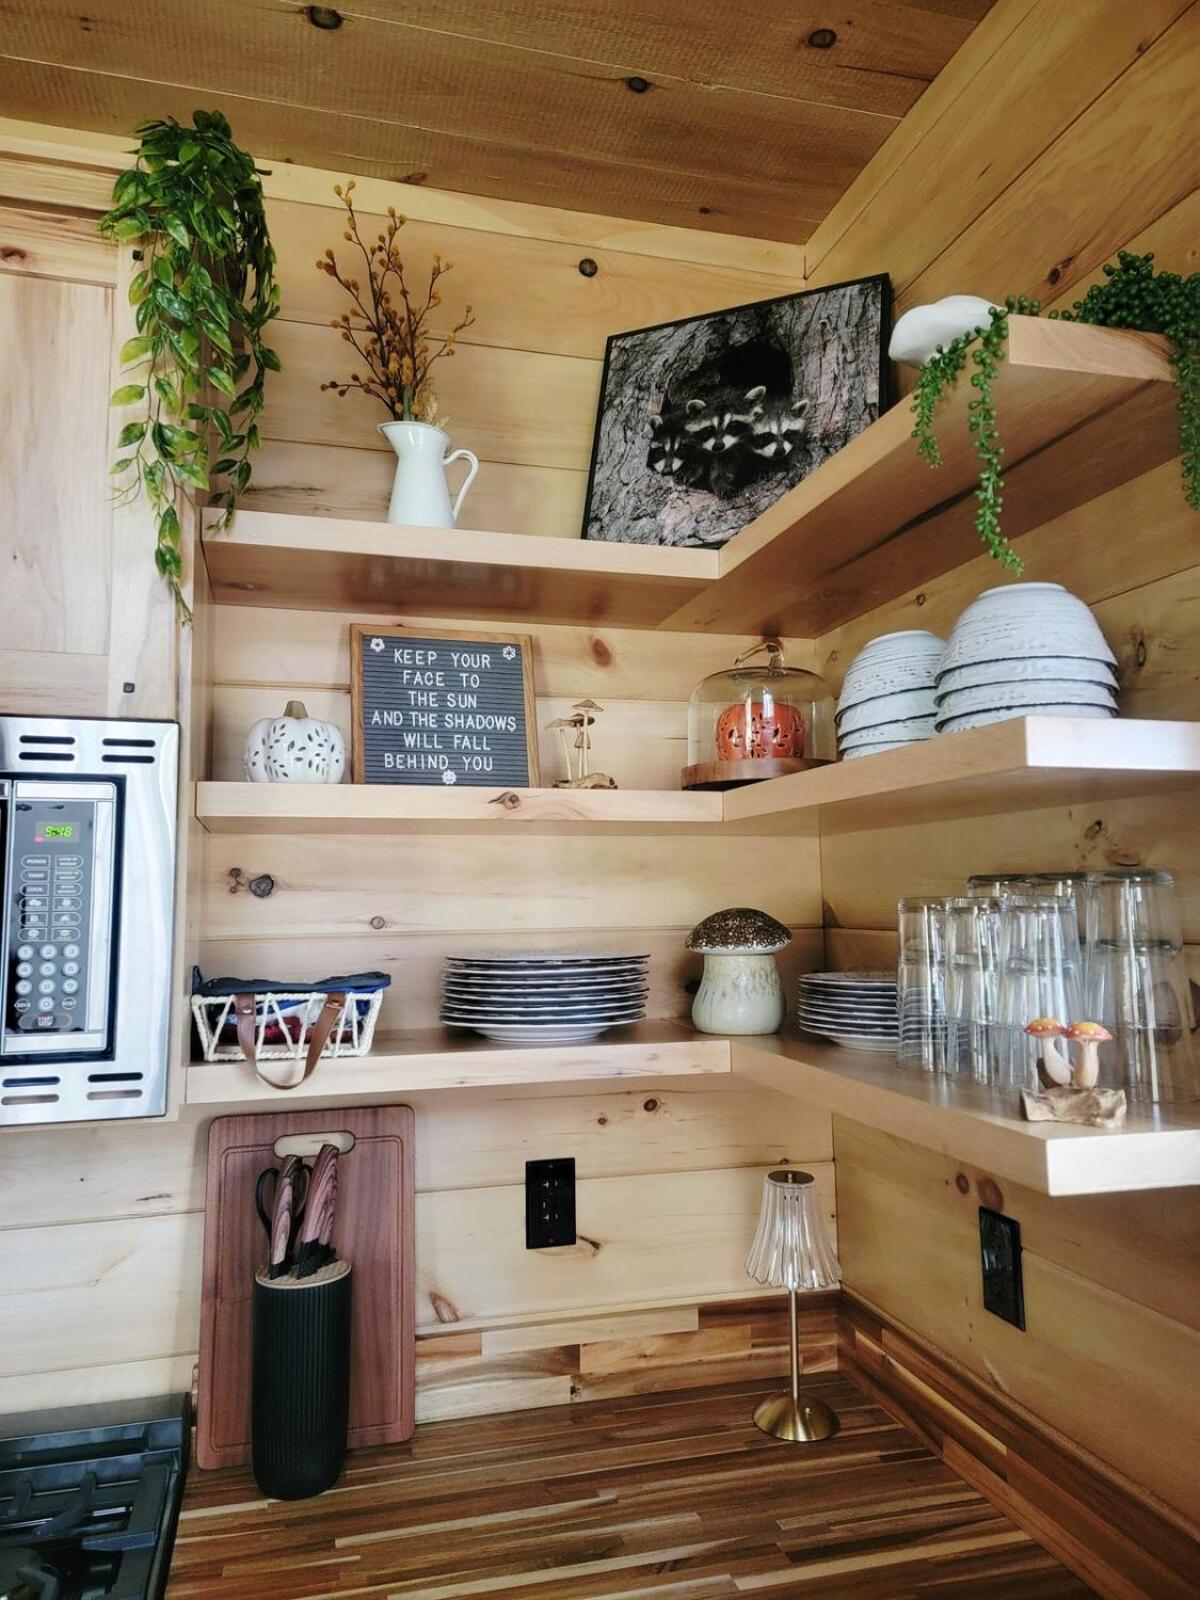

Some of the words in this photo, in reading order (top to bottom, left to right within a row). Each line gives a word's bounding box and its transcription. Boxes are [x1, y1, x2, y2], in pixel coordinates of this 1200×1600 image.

[394, 649, 437, 665] KEEP
[451, 653, 491, 668] YOUR
[403, 670, 445, 686] FACE
[460, 673, 480, 688] TO
[408, 691, 438, 706] THE
[447, 693, 477, 708] SUN
[371, 710, 403, 726] AND
[410, 711, 438, 728] THE
[444, 714, 516, 732] SHADOWS
[403, 732, 443, 748] WILL
[454, 735, 491, 750] FALL
[384, 753, 449, 769] BEHIND
[463, 756, 493, 772] YOU
